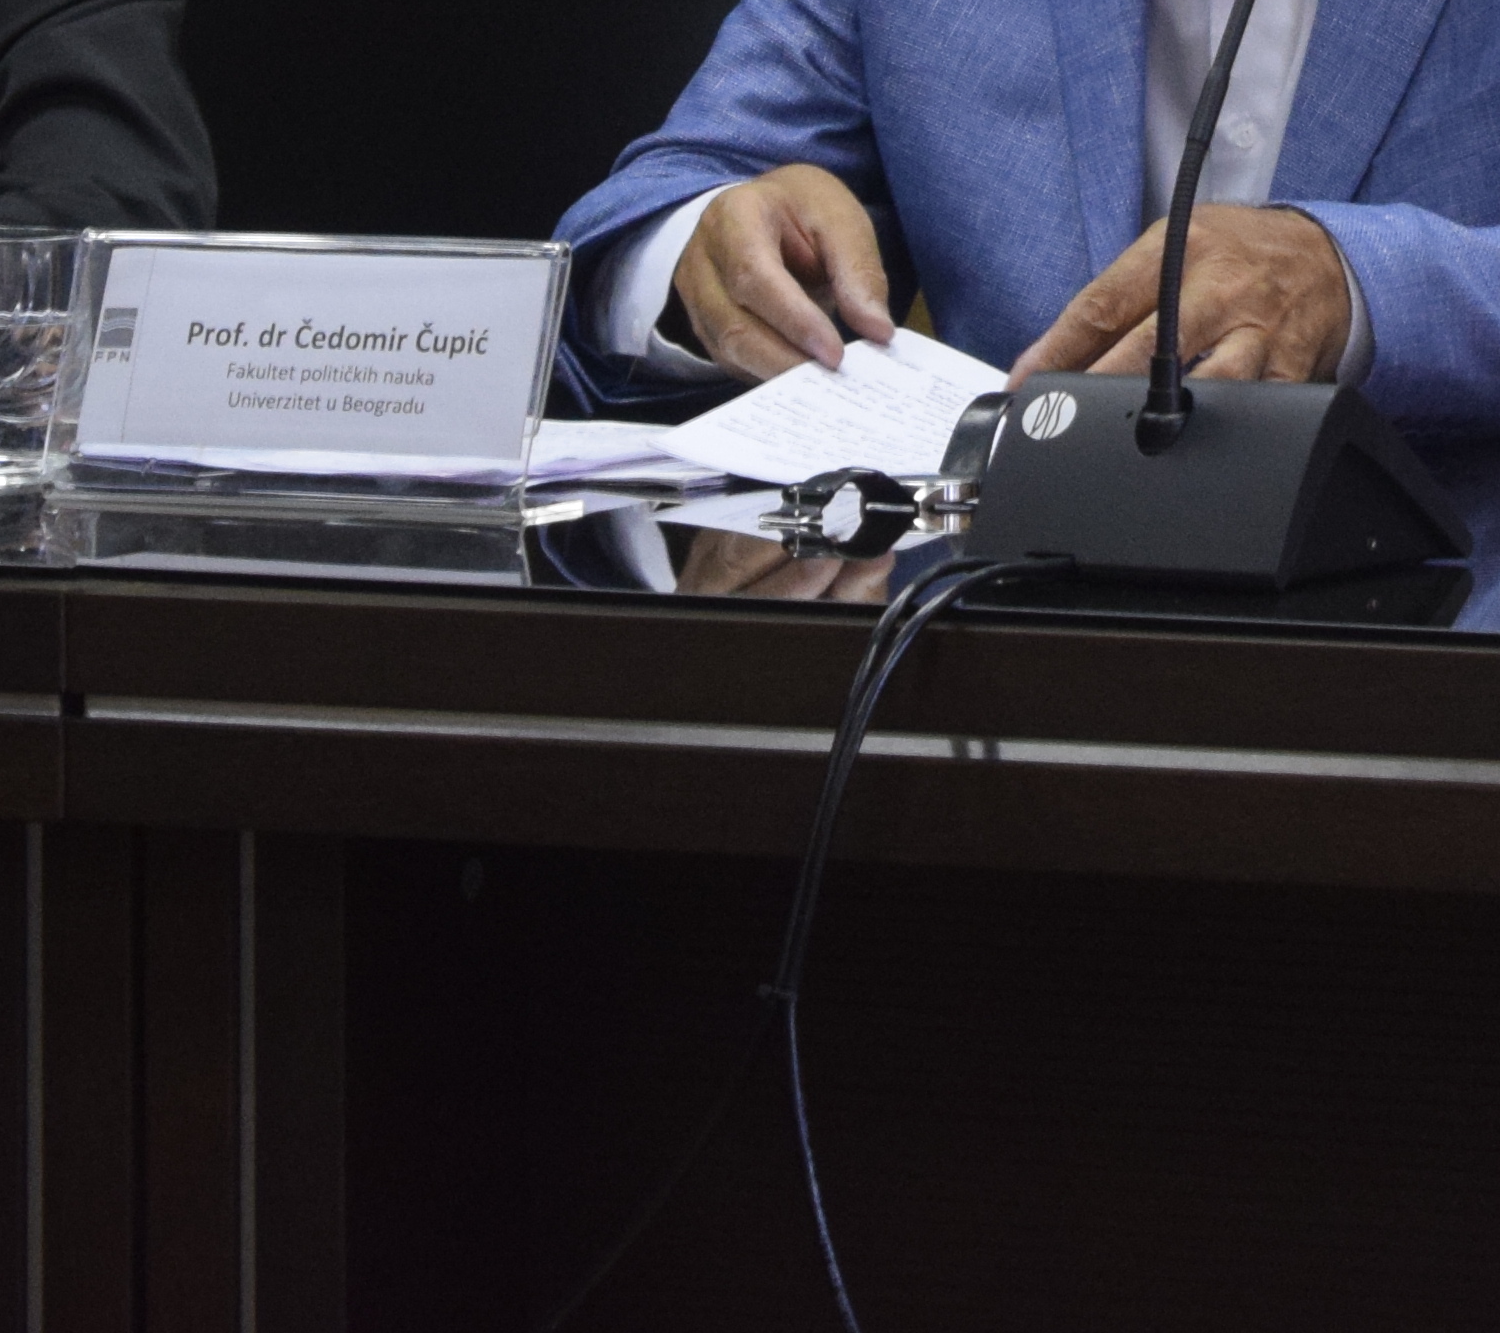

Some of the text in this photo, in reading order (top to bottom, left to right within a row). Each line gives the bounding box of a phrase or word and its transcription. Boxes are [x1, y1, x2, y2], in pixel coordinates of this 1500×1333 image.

[187, 317, 489, 360] Prof. dr Čedomir Čupić
[94, 350, 131, 364] FPN
[226, 363, 435, 388] Fakultet političkih nauka
[227, 391, 425, 417] Univerzitet u Beogradu
